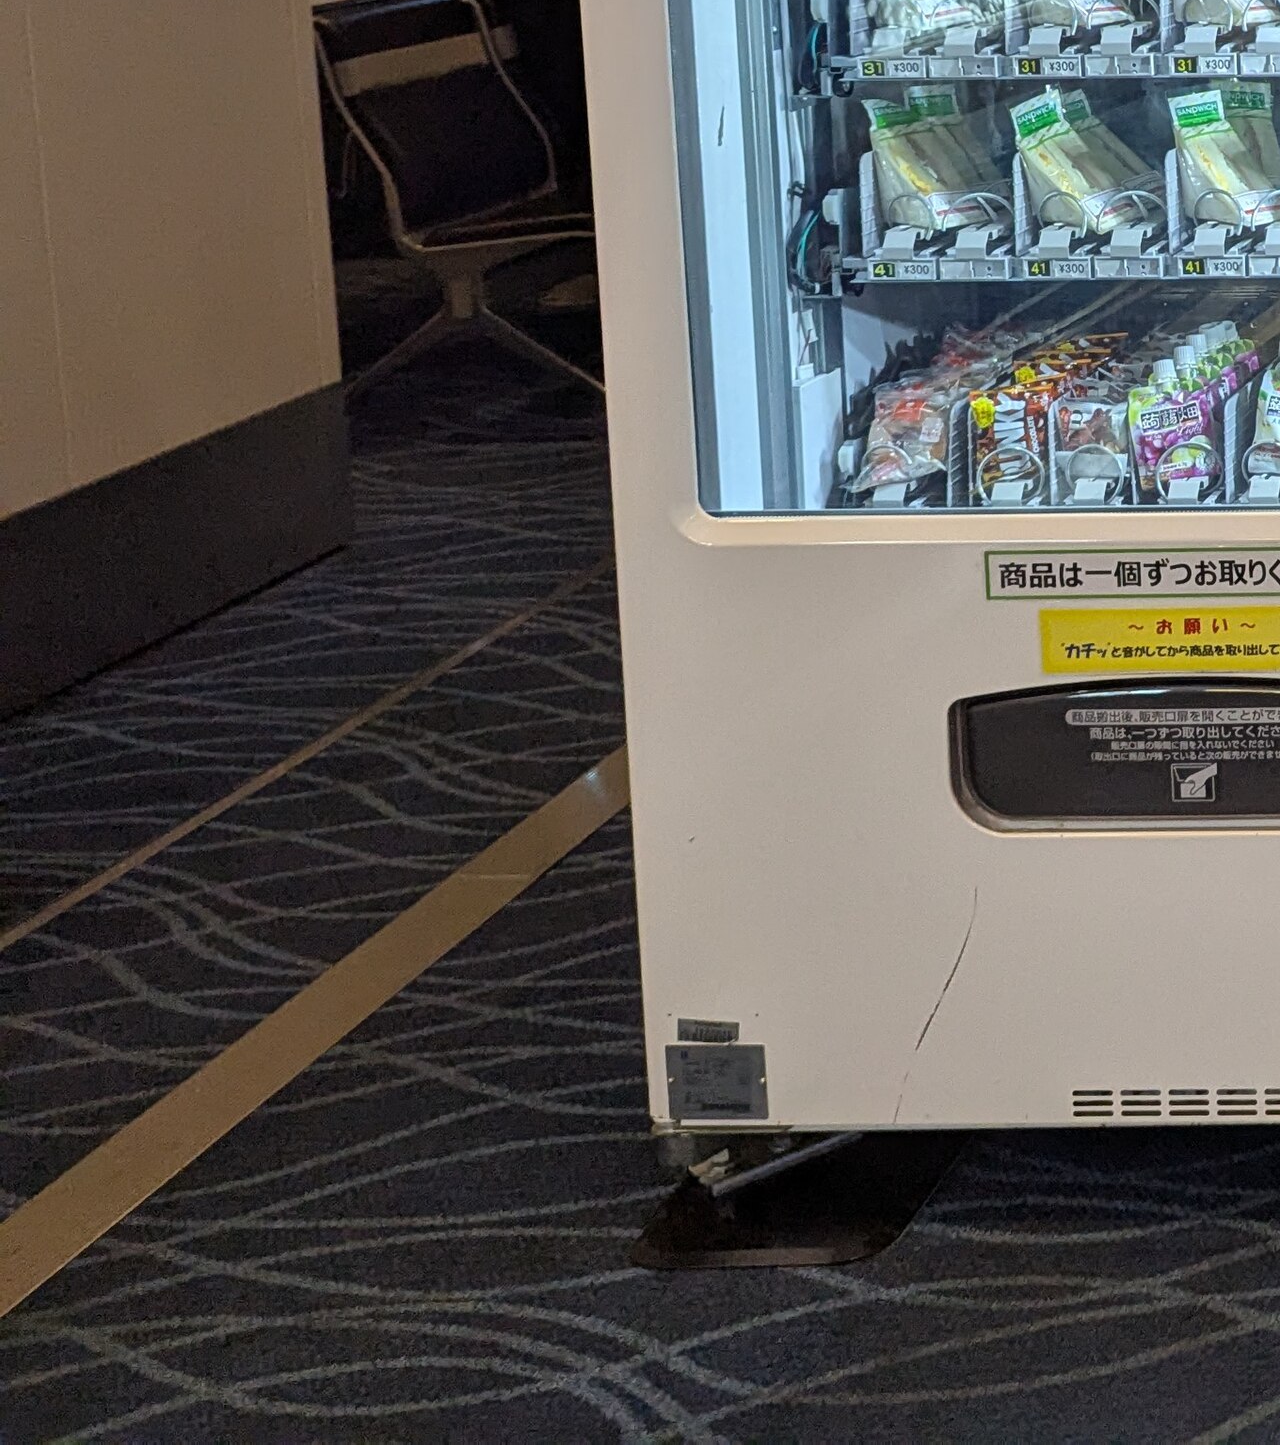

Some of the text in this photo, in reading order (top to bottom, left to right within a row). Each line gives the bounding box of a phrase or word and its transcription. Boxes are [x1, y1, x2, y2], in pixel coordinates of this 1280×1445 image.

[1017, 102, 1056, 125] SANDWICH
[1177, 103, 1218, 116] SANDWICH
[874, 263, 929, 277] 41 ¥300
